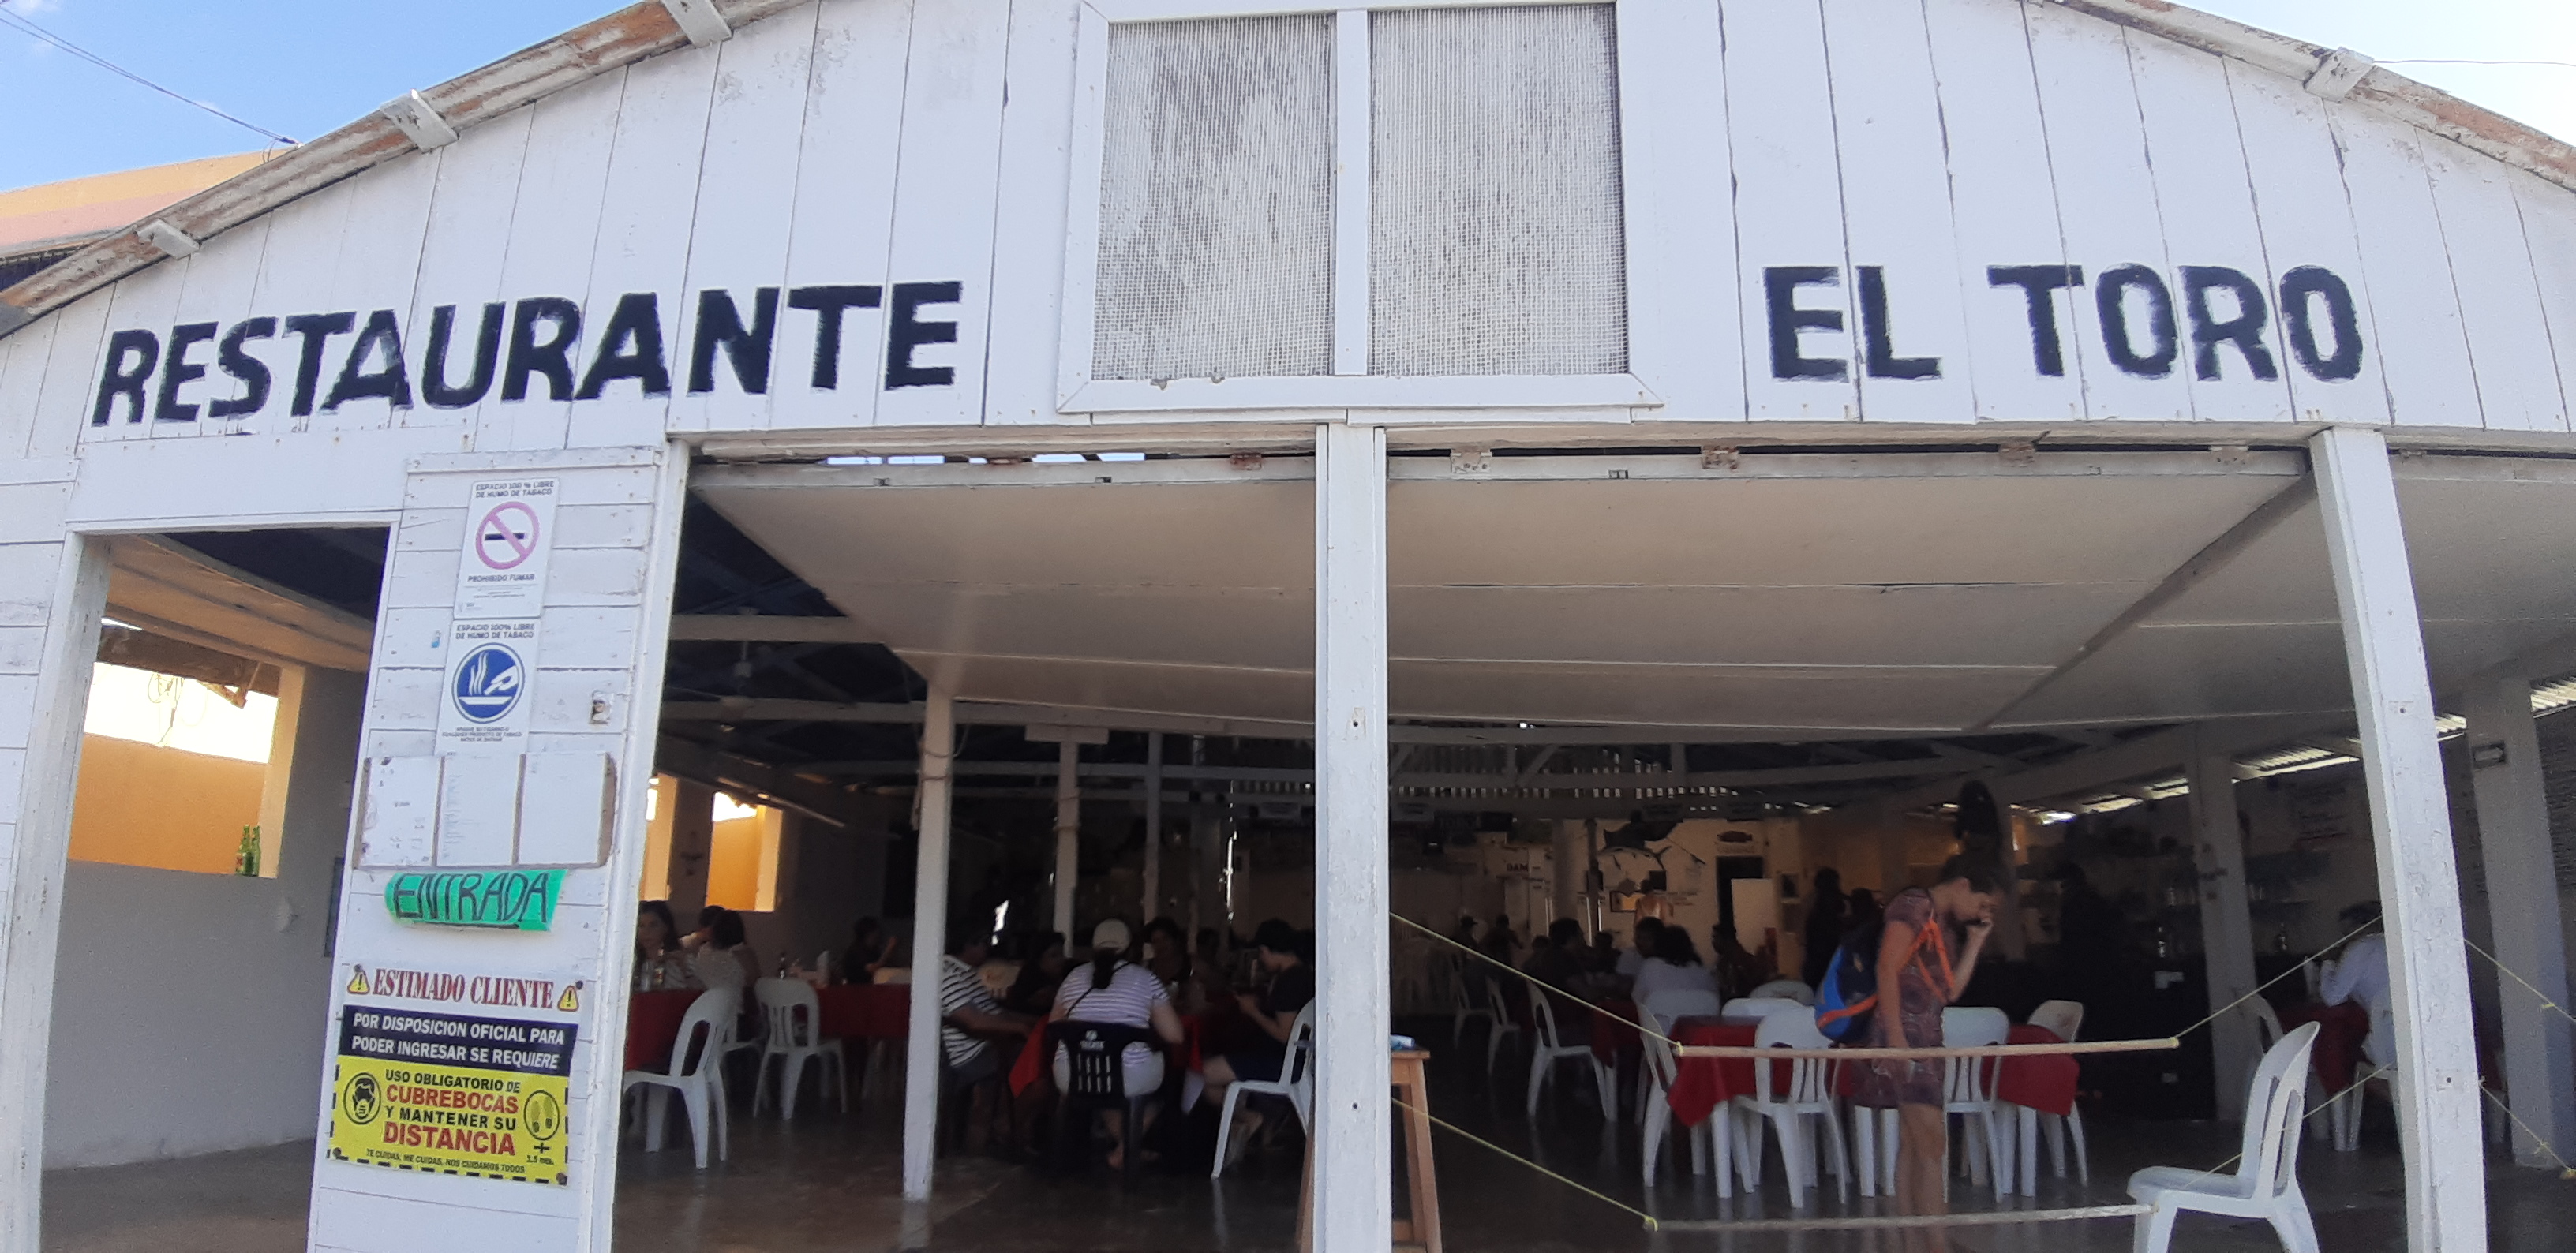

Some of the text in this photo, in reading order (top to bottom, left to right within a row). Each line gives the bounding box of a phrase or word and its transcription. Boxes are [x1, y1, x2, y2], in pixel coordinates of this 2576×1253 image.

[91, 261, 2364, 428] RESTAURANTE EL TORO
[393, 871, 549, 922] ENTRADA
[372, 968, 554, 1008] ESTIMADO CLIENTE
[354, 1012, 564, 1045] POR DISPOSICION OFICIAL PARA
[352, 1035, 560, 1069] PODER INGRESAR SE REQUIERE
[385, 1069, 521, 1094] USO OBLIGATORIO DE
[386, 1084, 519, 1114] CUBREBOCAS
[385, 1105, 516, 1130] Y MANTENER SU
[383, 1121, 516, 1156] DISTANCIA
[366, 1148, 375, 1157] TE
[445, 1158, 460, 1168] NOS
[500, 1164, 525, 1173] TODOS
